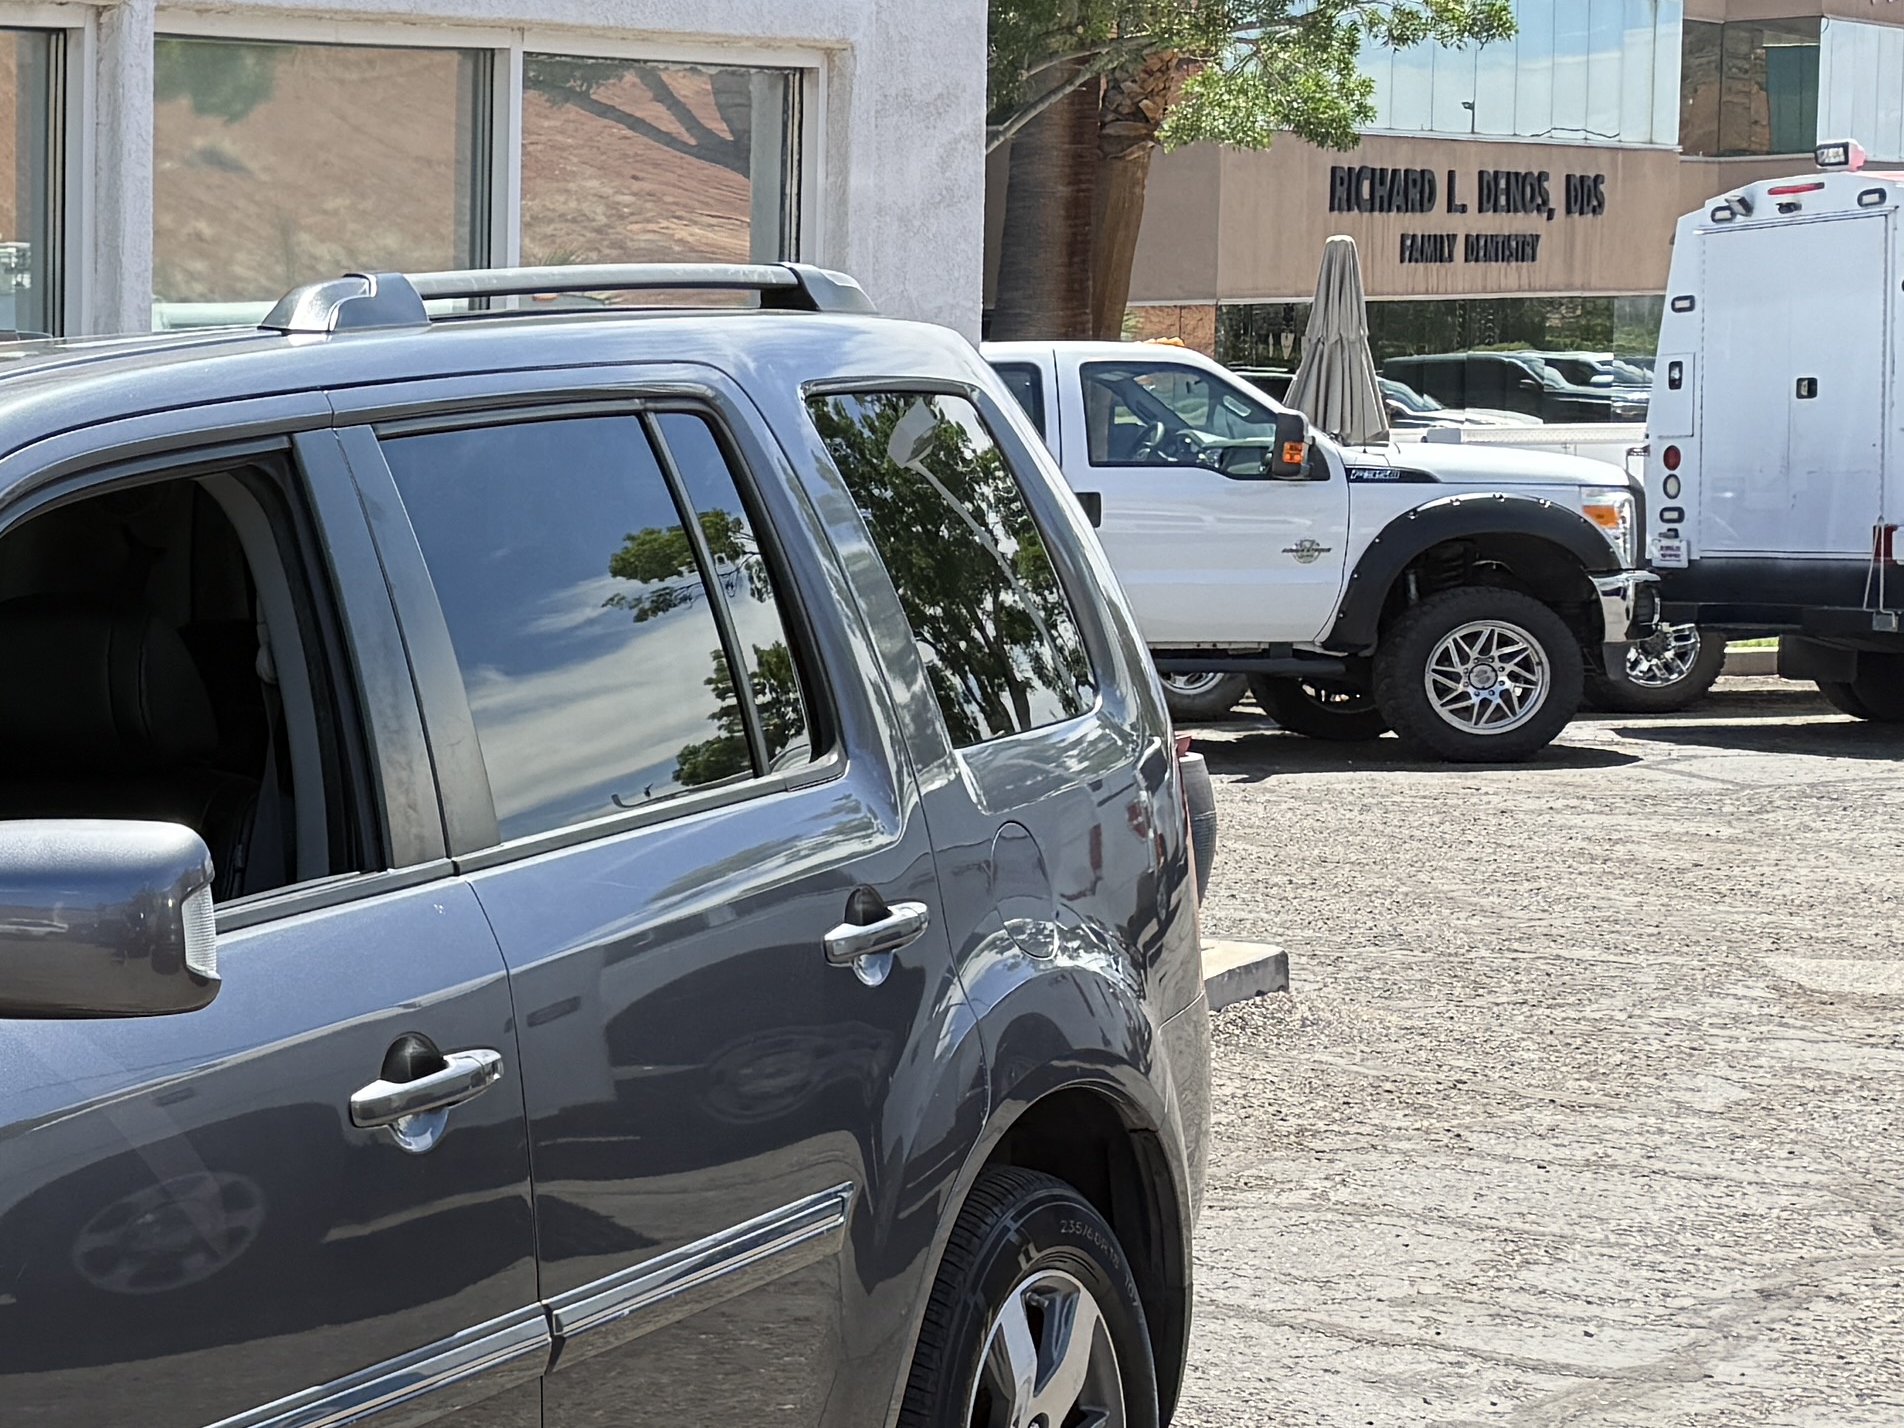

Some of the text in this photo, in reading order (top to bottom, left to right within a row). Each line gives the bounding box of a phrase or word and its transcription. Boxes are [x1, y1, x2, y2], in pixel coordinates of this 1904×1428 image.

[1329, 166, 1605, 221] RICHARD L. DENOS, DDS
[1400, 233, 1541, 264] FAMILY DENTISTRY
